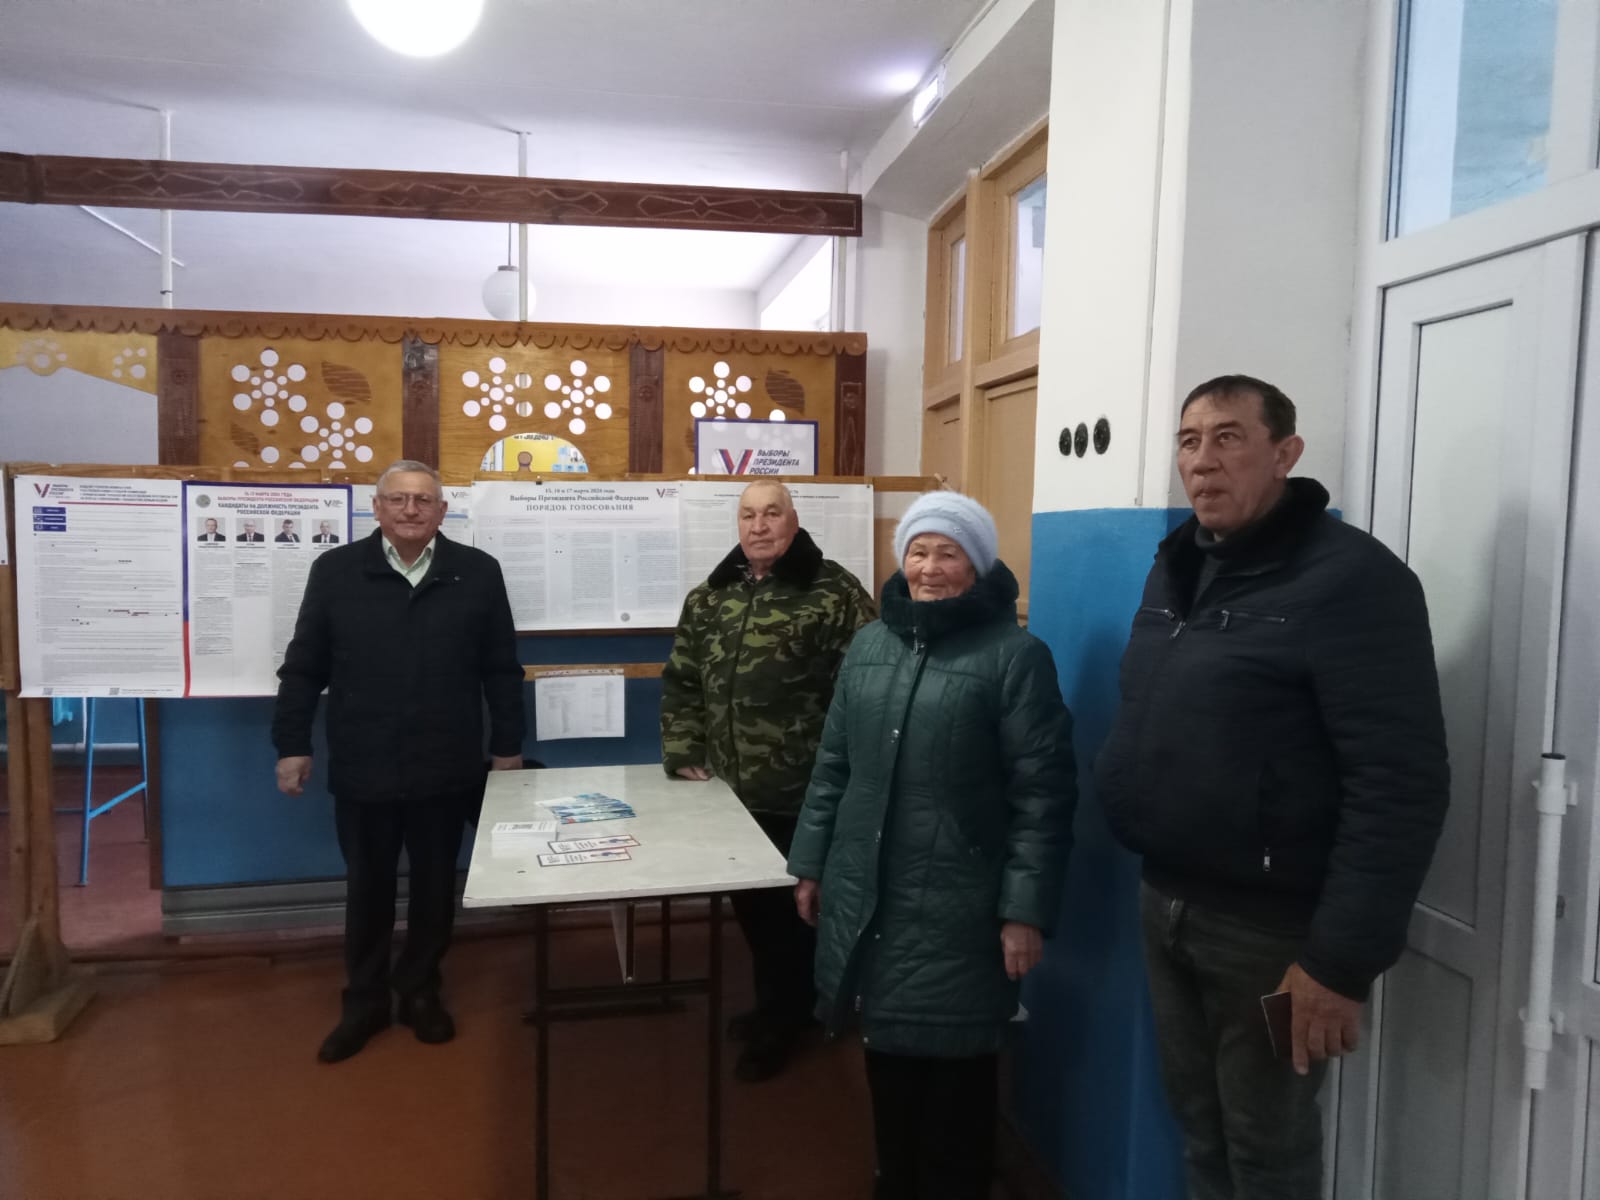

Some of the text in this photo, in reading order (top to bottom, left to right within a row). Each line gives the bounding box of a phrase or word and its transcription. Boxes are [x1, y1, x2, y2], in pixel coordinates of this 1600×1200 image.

[757, 449, 791, 457] ВЫБОРЫ
[753, 458, 800, 467] ПРЕЗИДЕНТА
[749, 467, 780, 475] РОССИИ
